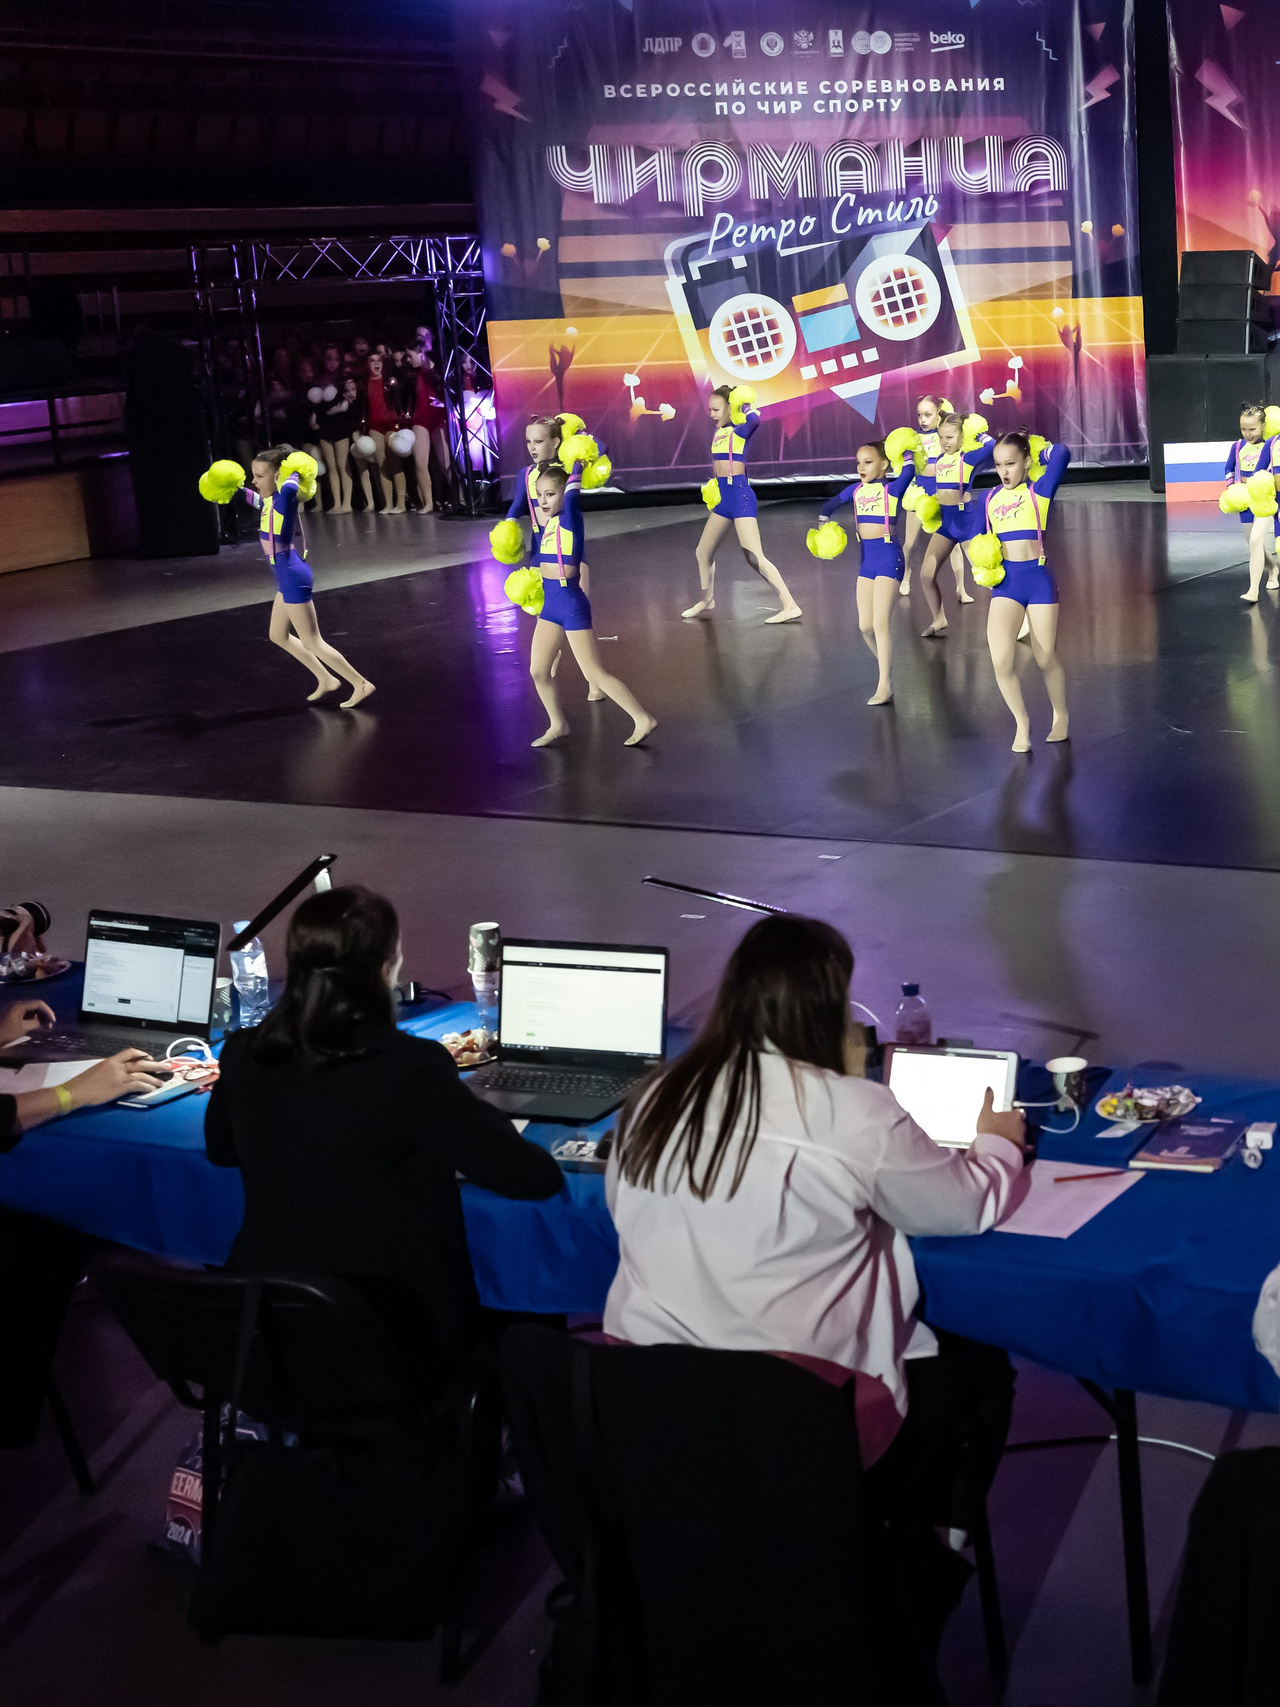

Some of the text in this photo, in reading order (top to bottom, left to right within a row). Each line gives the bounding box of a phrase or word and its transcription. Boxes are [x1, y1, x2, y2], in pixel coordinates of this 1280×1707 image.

[642, 37, 683, 55] ЛДПР
[929, 30, 966, 45] beko
[603, 77, 1006, 99] ВСЕРОССИЙСКИЕ СОРЕВНОВАНИЯ
[714, 98, 903, 116] ПО ЧИР СПОРТУ
[707, 192, 939, 256] Ретро Стиль
